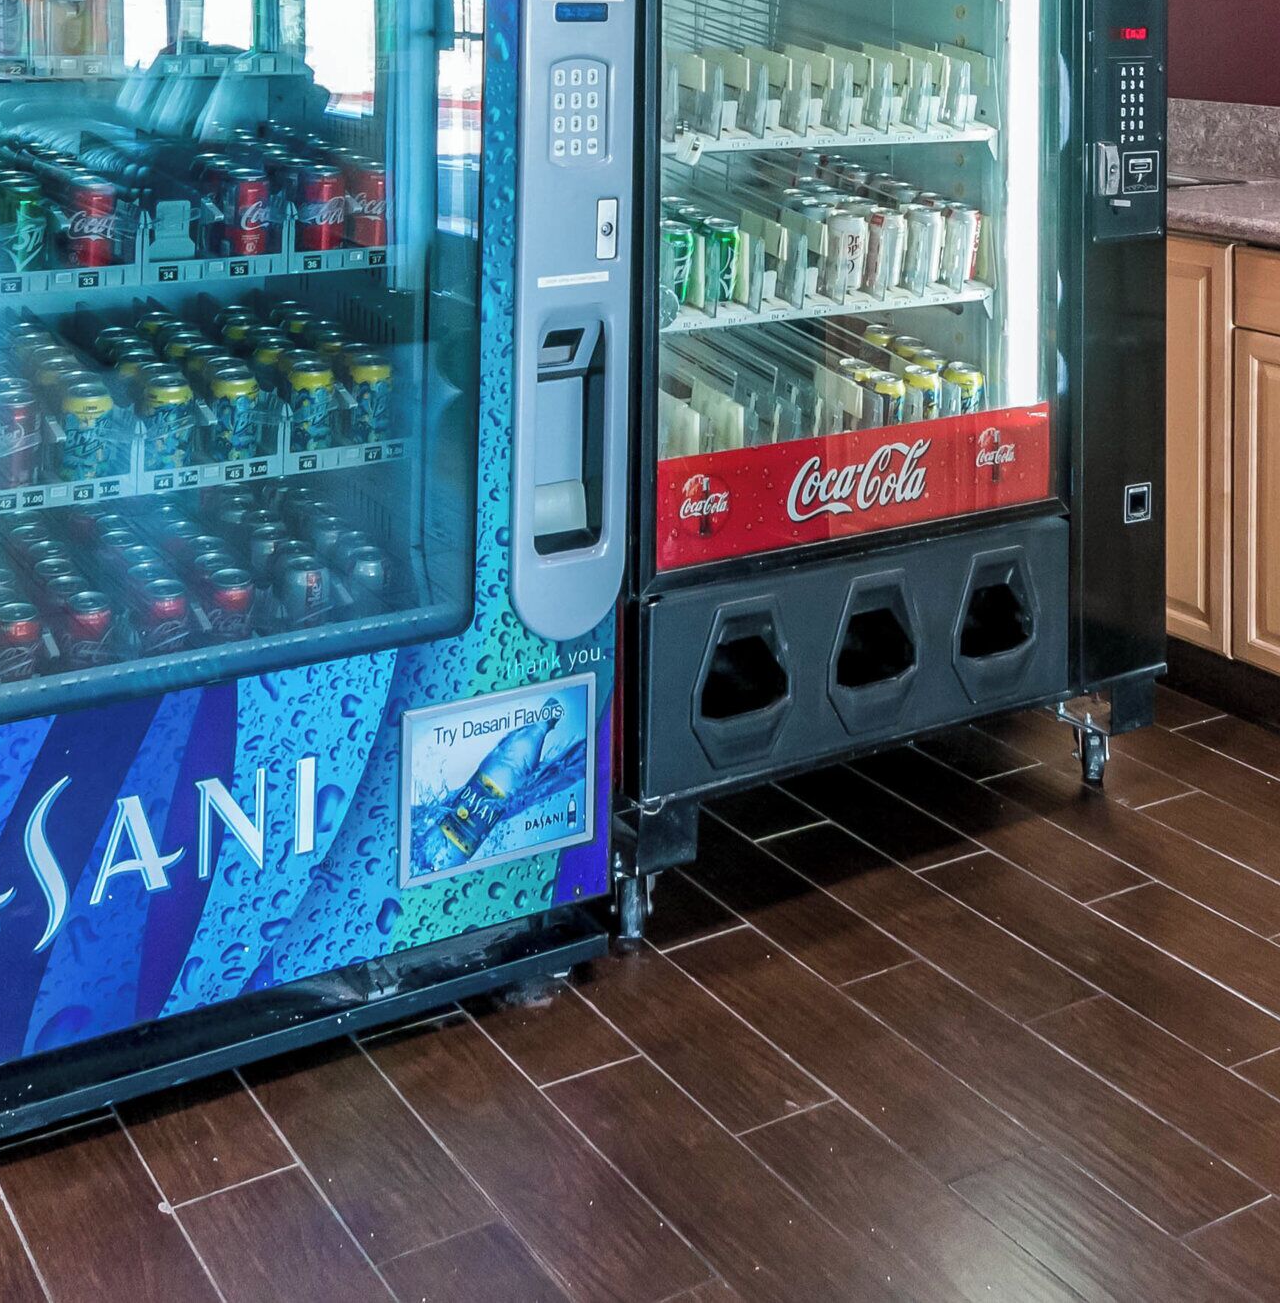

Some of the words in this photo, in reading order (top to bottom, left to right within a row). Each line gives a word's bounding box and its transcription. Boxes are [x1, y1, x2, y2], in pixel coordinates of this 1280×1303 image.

[1121, 67, 1126, 76] A
[1130, 67, 1135, 76] 1
[1121, 80, 1126, 90] B
[1130, 80, 1135, 89] 3
[1121, 94, 1126, 103] C
[1130, 94, 1135, 103] 5
[1121, 107, 1126, 117] D
[1130, 107, 1135, 116] 7
[1121, 121, 1126, 130] E
[1130, 120, 1135, 130] 9
[307, 260, 317, 268] 36
[372, 256, 381, 264] 37
[234, 266, 245, 274] 35
[163, 271, 174, 280] 34
[83, 277, 94, 285] 33
[5, 282, 17, 291] 32
[367, 451, 377, 459] 47
[976, 444, 1017, 468] Coca-Cola
[302, 460, 313, 468] 46
[229, 469, 240, 478] 45
[158, 479, 169, 487] 44
[787, 438, 932, 523] Coca-Cola
[78, 490, 88, 498] 43
[0, 500, 11, 508] 42
[680, 492, 729, 520] Coca-Cola
[505, 653, 562, 679] thank
[568, 646, 607, 673] you.
[434, 727, 457, 747] Try
[462, 713, 510, 739] Dasani
[525, 813, 564, 831] DASANI
